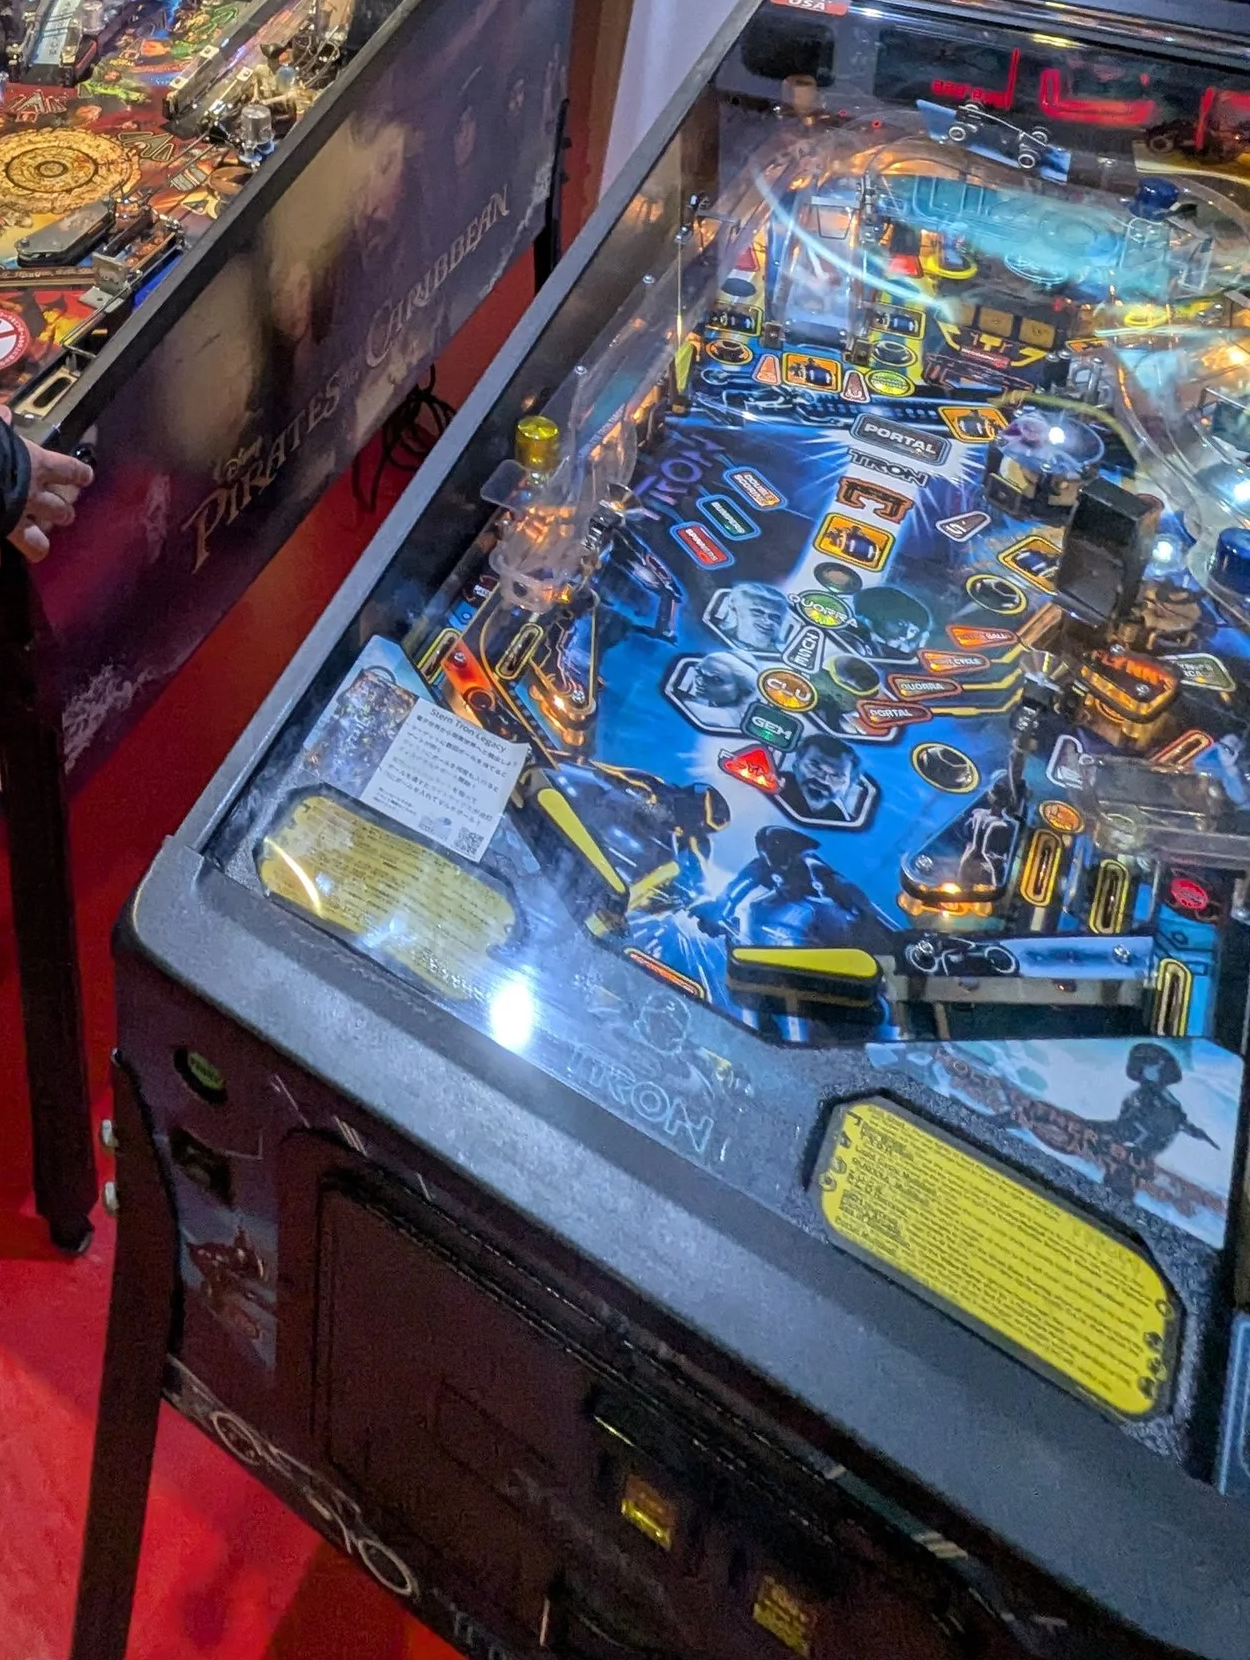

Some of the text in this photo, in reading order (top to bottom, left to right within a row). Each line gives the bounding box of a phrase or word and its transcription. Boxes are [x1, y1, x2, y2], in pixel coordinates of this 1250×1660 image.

[366, 183, 512, 369] CARIBBEAN
[863, 423, 938, 455] PORTAL
[847, 448, 929, 488] TRON
[787, 593, 859, 629] QUORRA
[765, 677, 813, 702] CLU
[900, 681, 944, 691] QUORRA
[751, 715, 793, 741] GEM
[869, 707, 914, 719] PORTAL
[428, 707, 507, 754] Stern Tron Legacy
